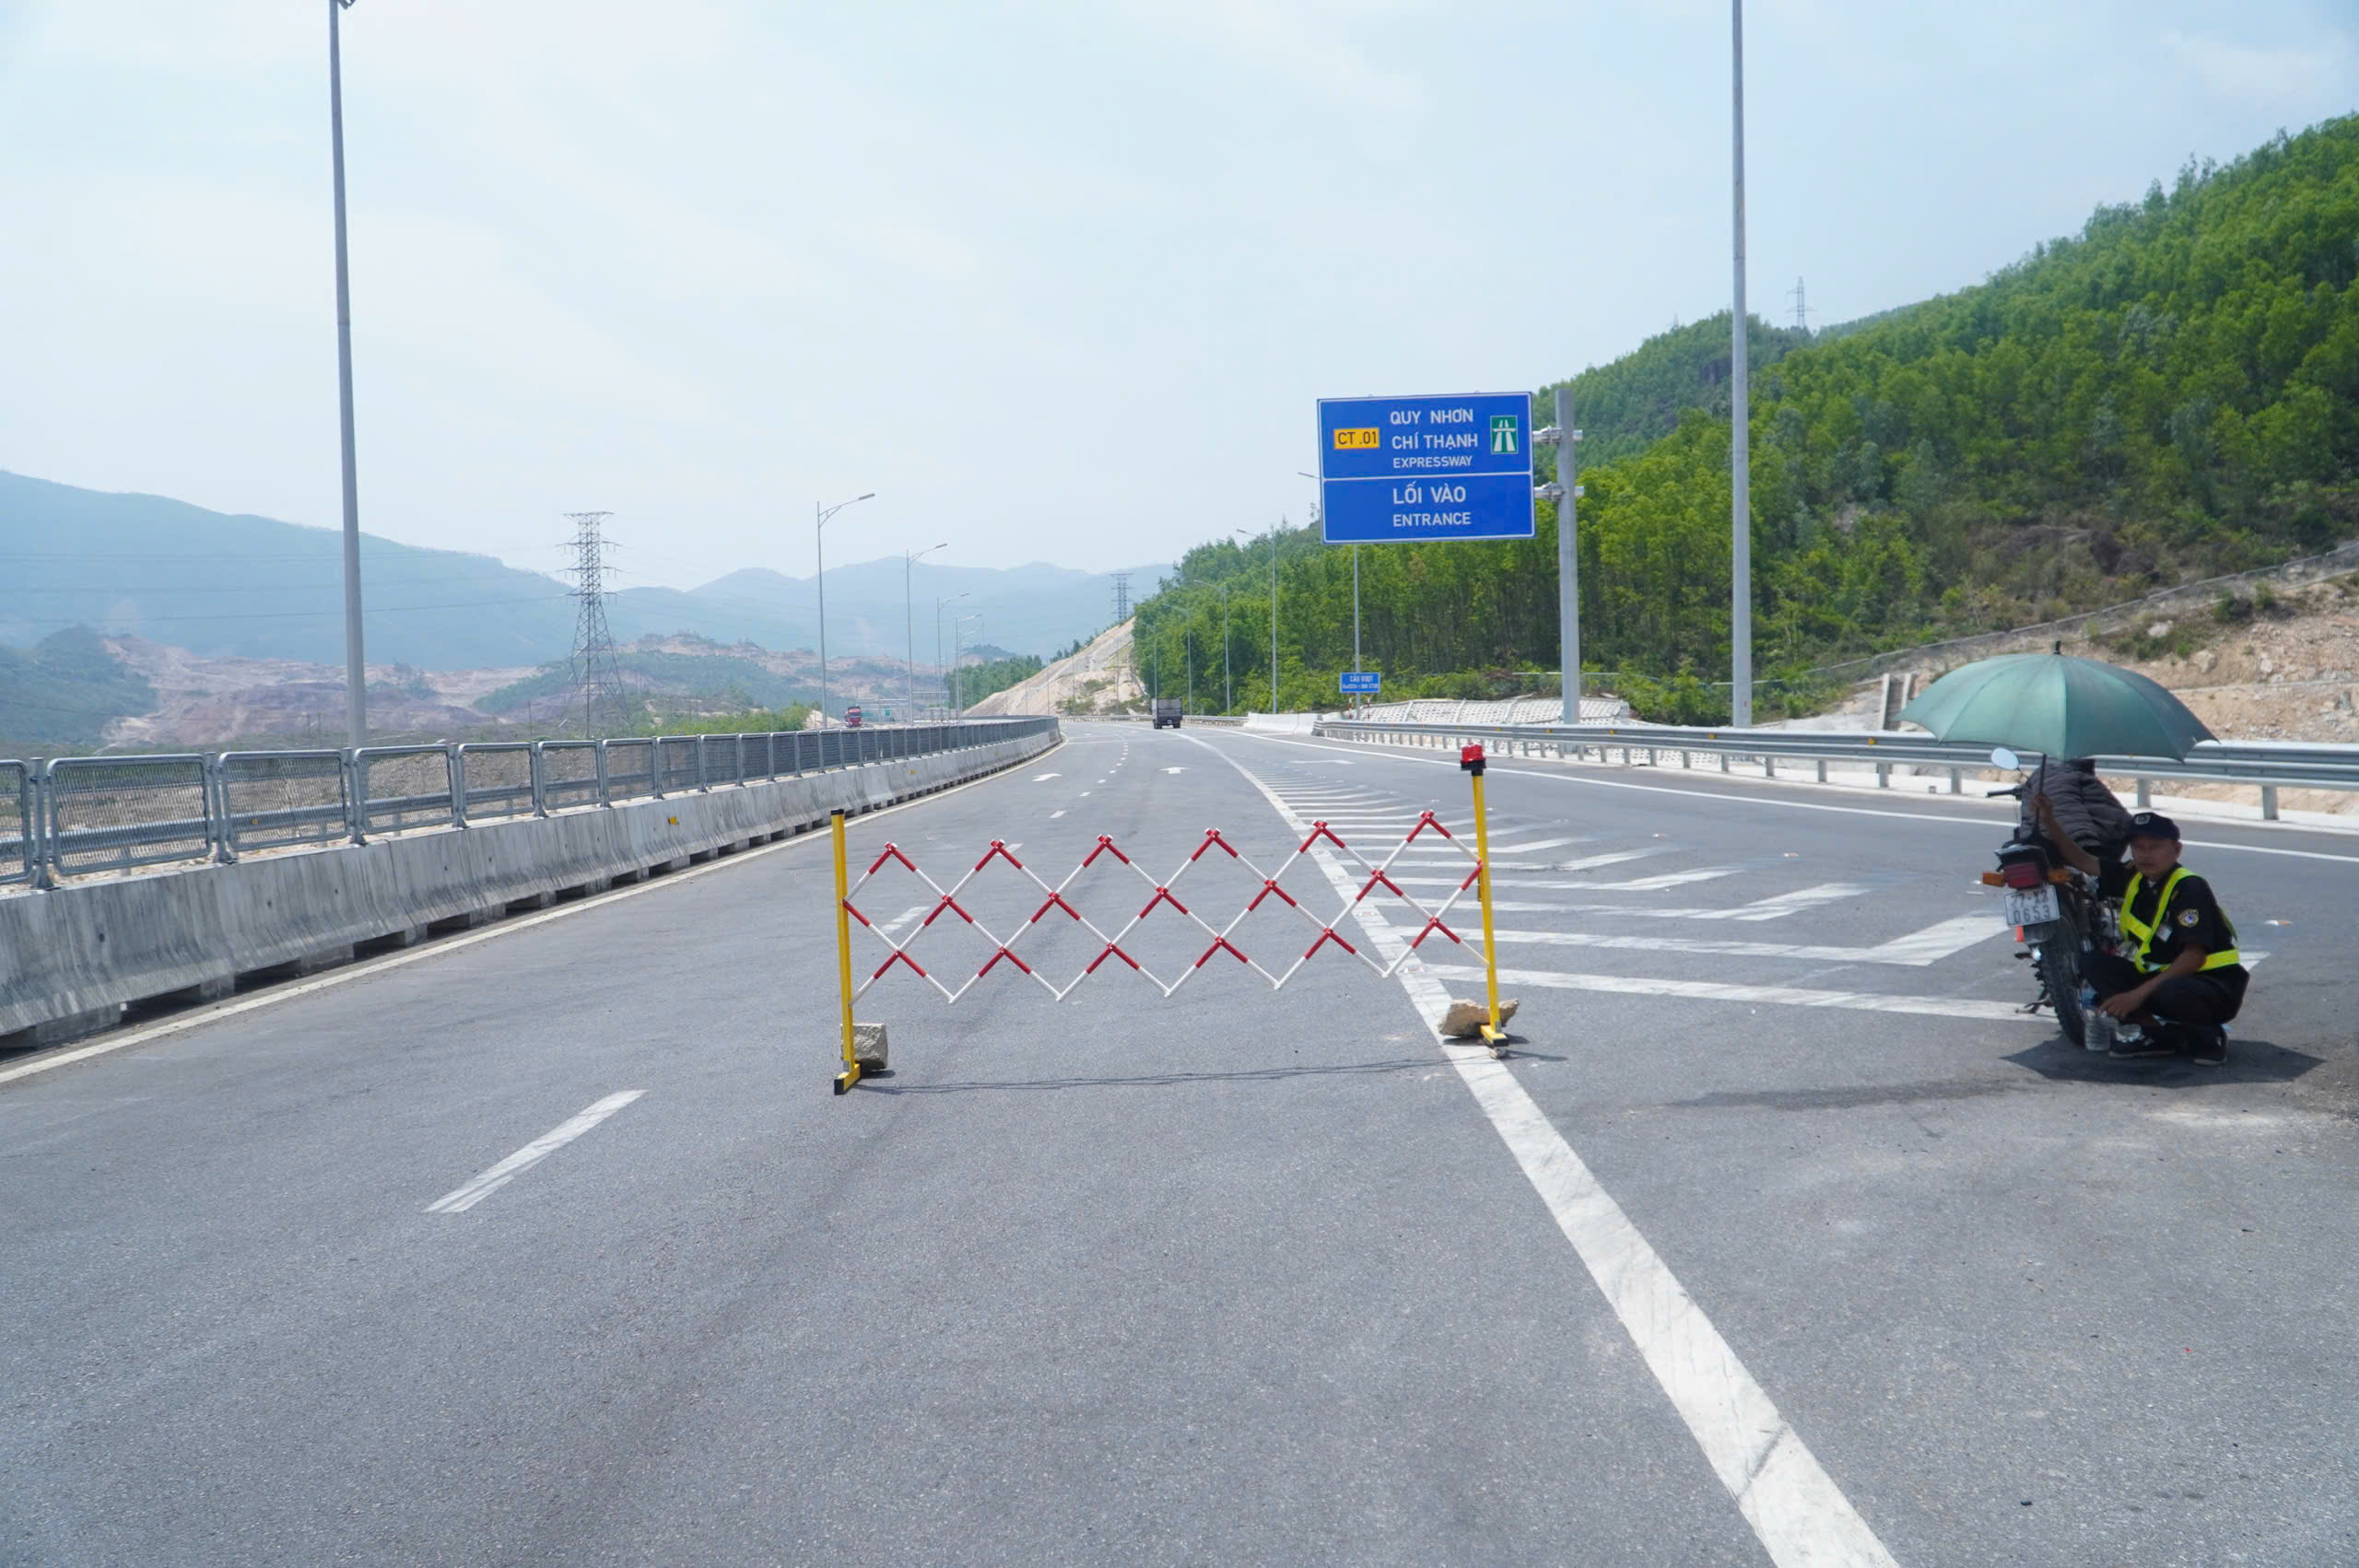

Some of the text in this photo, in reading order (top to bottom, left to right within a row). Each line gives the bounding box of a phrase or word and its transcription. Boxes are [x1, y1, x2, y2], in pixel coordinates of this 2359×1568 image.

[1390, 408, 1473, 425] QUY NHƠN
[1391, 432, 1478, 451] CHÍ THẠNH
[1392, 455, 1473, 469] EXPRESSWAY
[1392, 481, 1466, 504] LỐI VÀO
[1392, 511, 1471, 527] ENTRANCE
[2013, 905, 2050, 923] 0653
